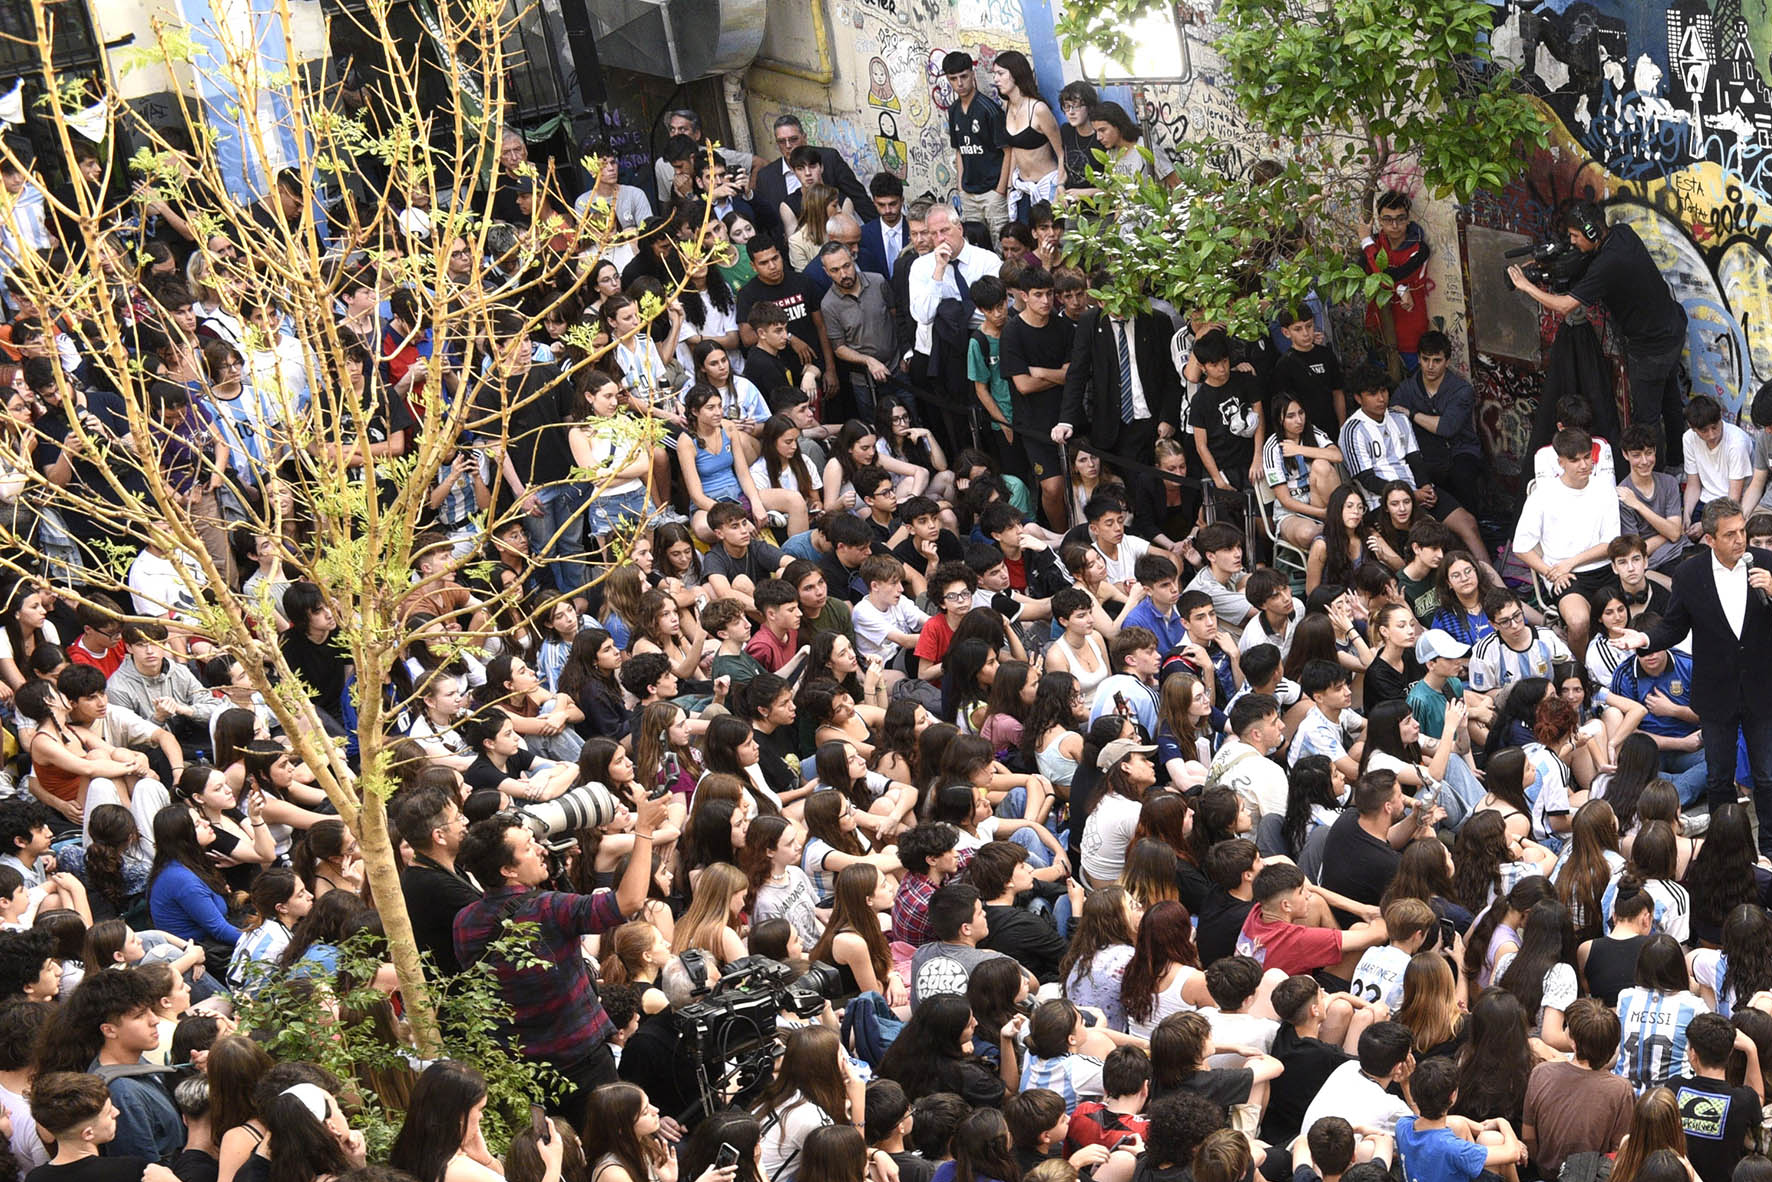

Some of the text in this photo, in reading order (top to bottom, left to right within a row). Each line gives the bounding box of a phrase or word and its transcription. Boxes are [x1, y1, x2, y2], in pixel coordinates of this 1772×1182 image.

[1367, 439, 1383, 461] 10
[919, 957, 964, 977] RIP
[916, 974, 968, 994] CURL
[1629, 1009, 1672, 1027] MESSI
[1624, 1031, 1673, 1089] 10
